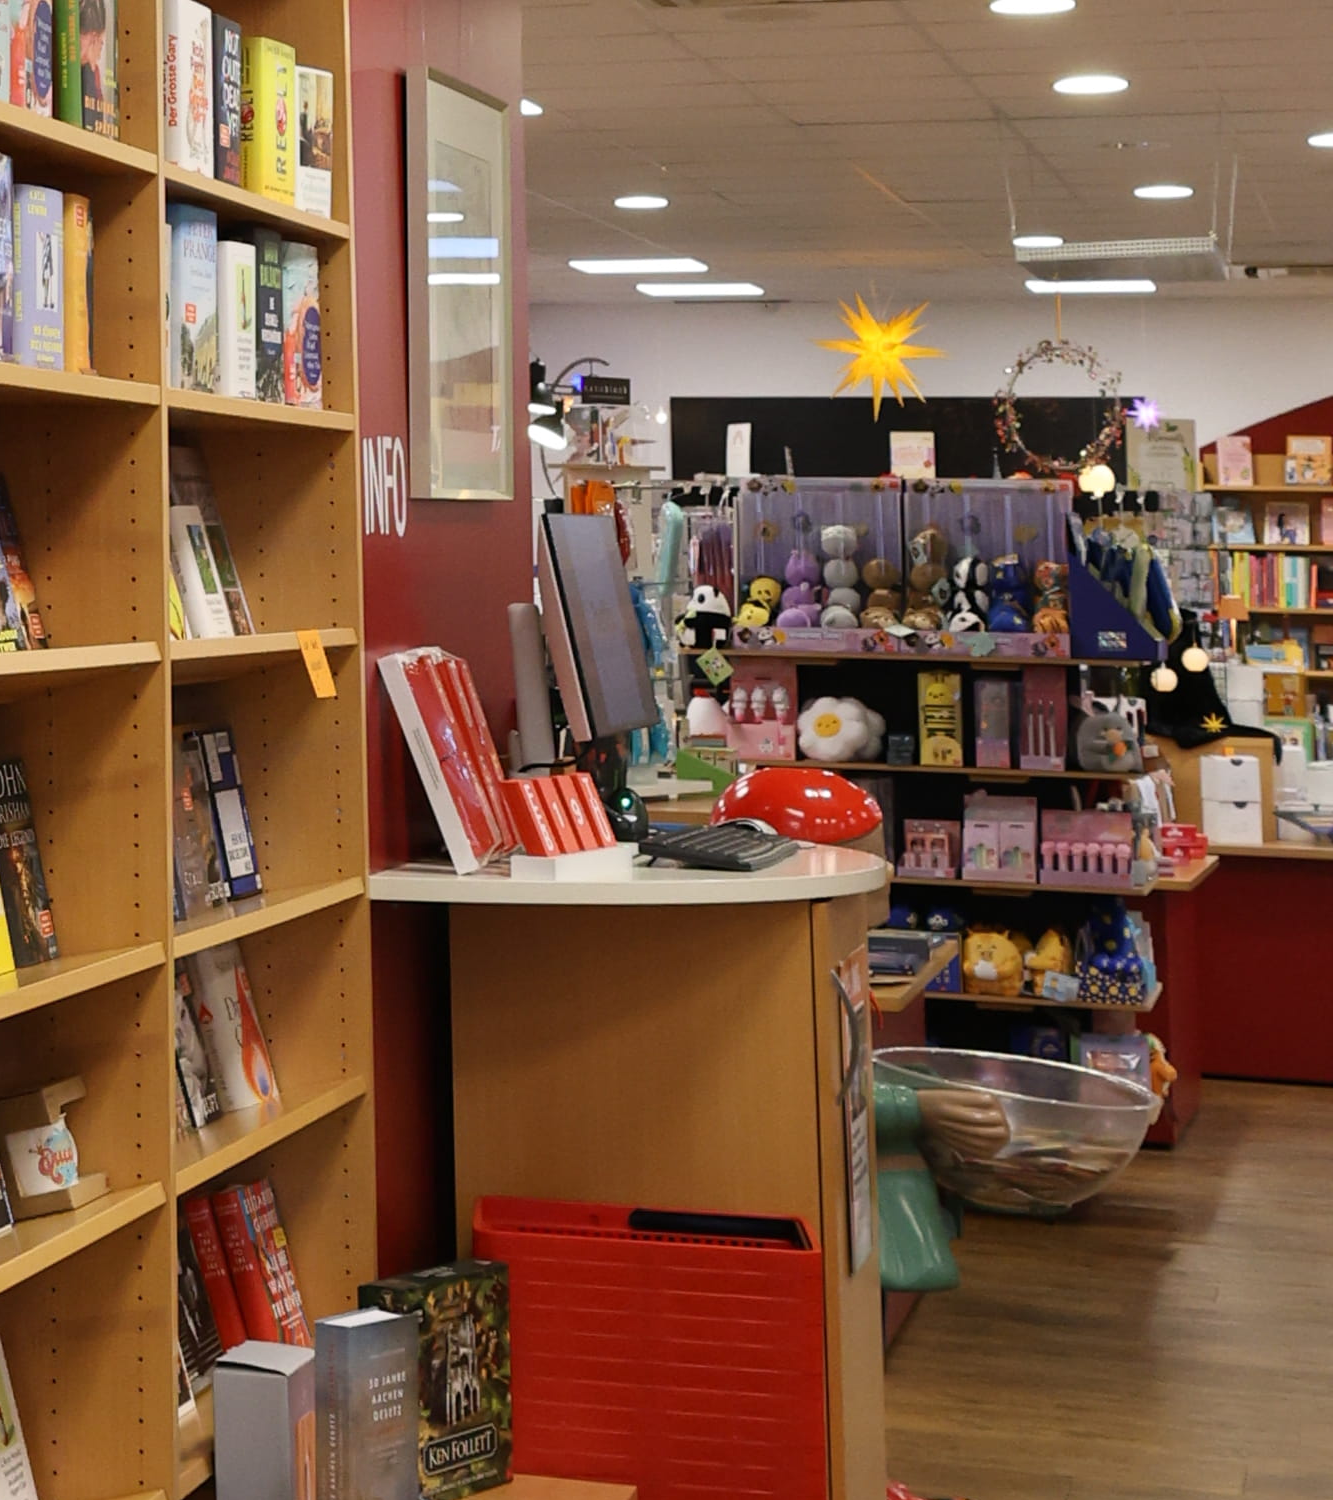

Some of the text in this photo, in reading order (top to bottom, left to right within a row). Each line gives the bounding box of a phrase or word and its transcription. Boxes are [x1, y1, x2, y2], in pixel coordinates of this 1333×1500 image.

[168, 33, 178, 127] Der Grosse Gary
[362, 435, 406, 538] INFO
[427, 1428, 496, 1469] KEN FOLLETT
